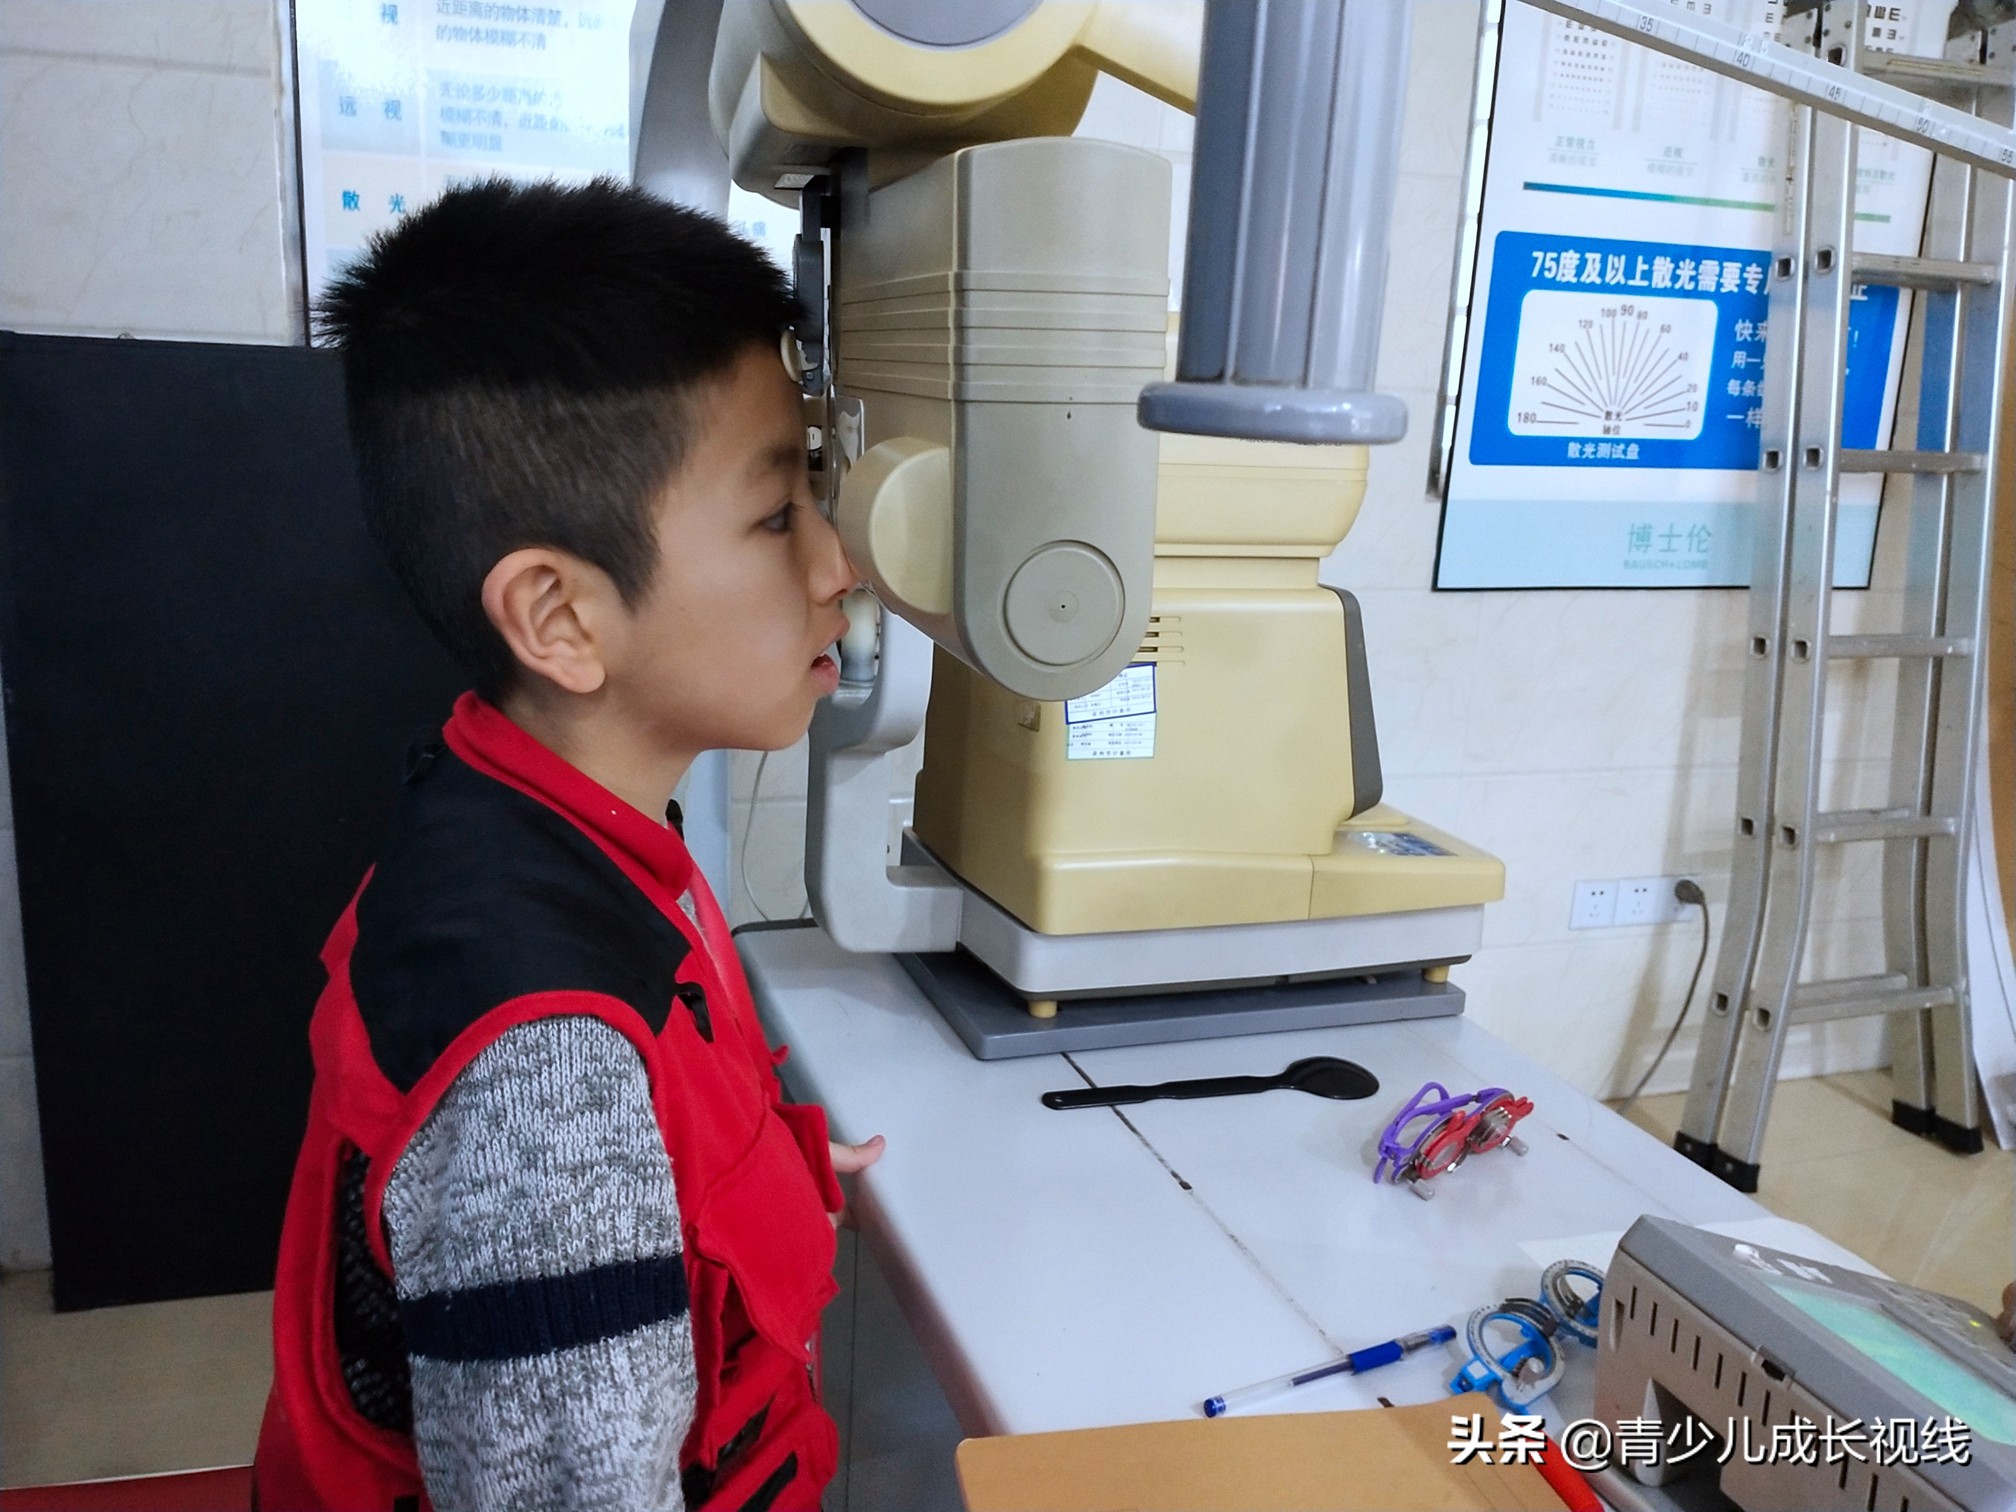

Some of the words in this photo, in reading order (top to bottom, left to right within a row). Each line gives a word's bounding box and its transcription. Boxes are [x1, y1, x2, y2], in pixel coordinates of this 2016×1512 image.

[1639, 15, 1653, 33] 35
[1737, 51, 1750, 68] 40
[1828, 84, 1841, 99] 45
[342, 190, 406, 214] 散光
[1532, 250, 1771, 295] 75度及以上散光需要专
[1600, 308, 1617, 318] 100
[1621, 304, 1634, 316] 90
[1637, 310, 1648, 320] 80
[1578, 319, 1593, 330] 120
[1660, 324, 1671, 334] 60
[1549, 343, 1565, 354] 140
[1678, 352, 1688, 361] 40
[1731, 350, 1765, 369] 用一
[1531, 376, 1547, 386] 160
[1686, 383, 1697, 393] 20
[1686, 401, 1699, 412] 10
[1518, 413, 1536, 424] 180
[1567, 442, 1640, 460] 散光测试盘
[1627, 522, 1713, 554] 博士伦
